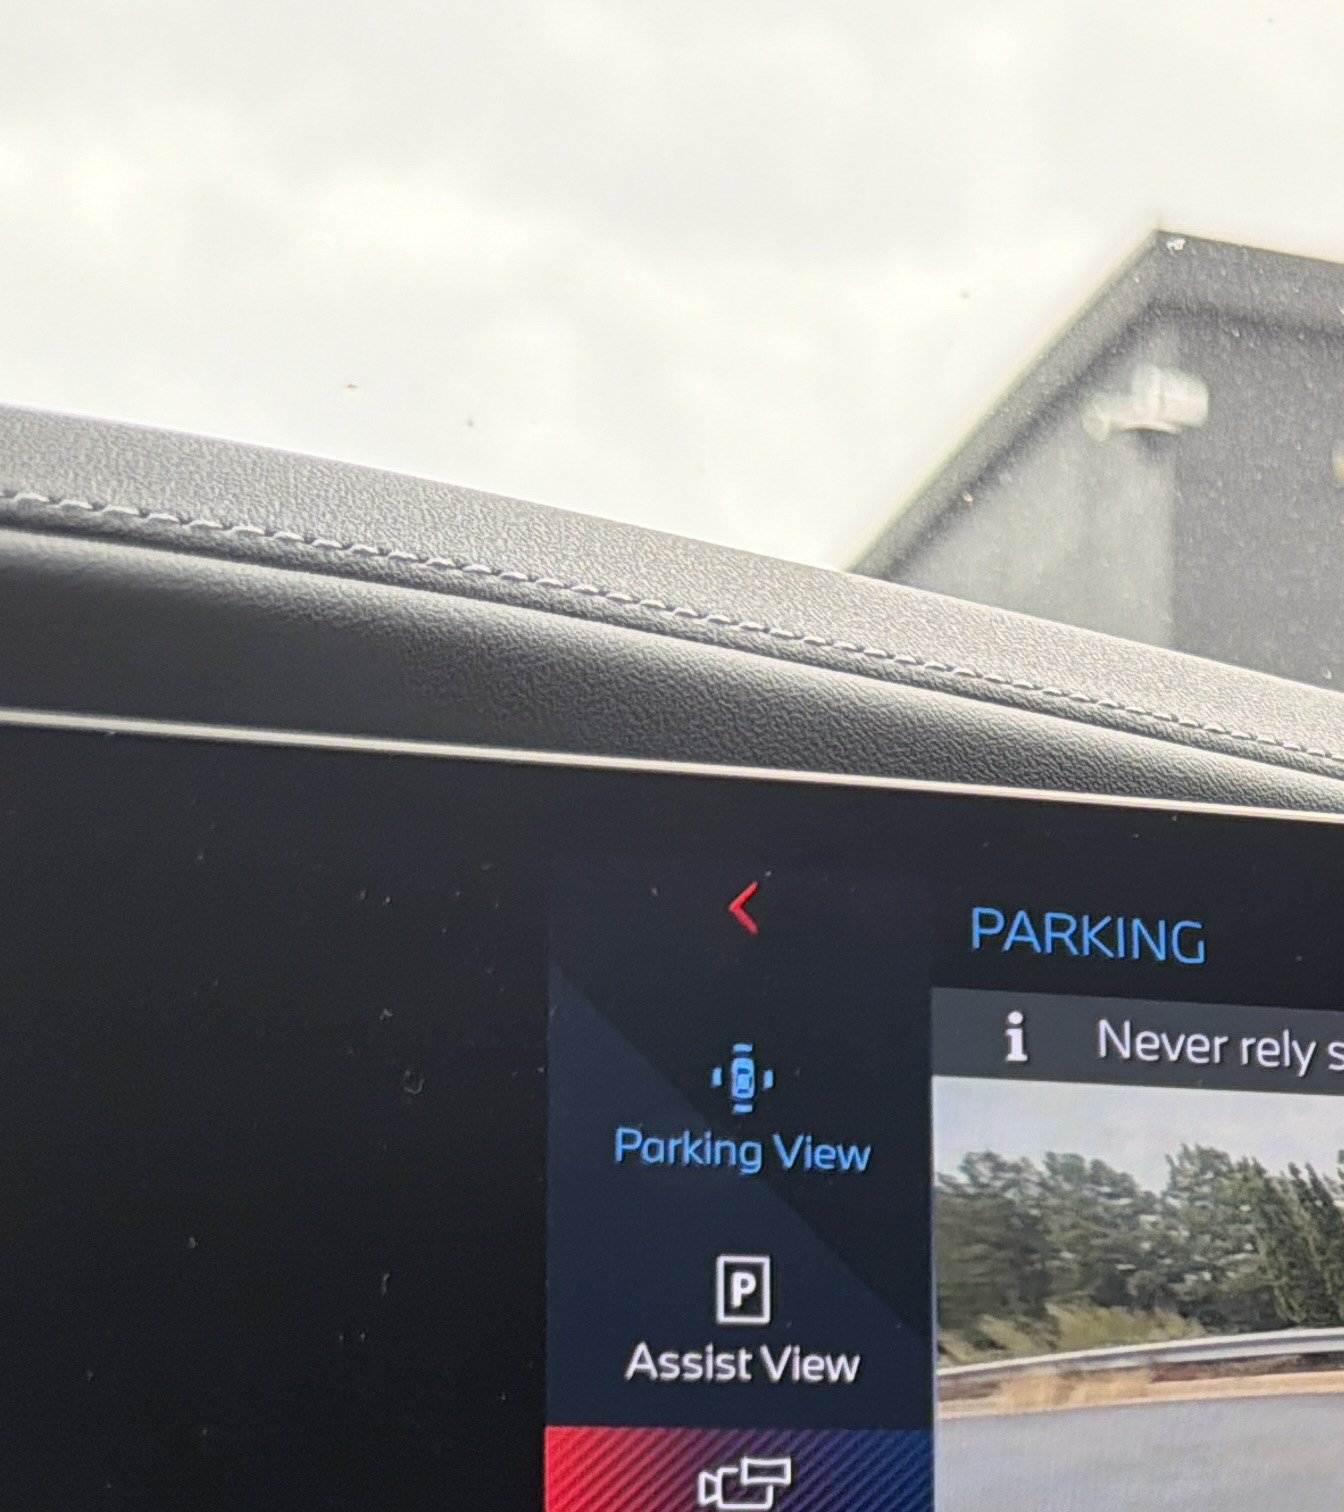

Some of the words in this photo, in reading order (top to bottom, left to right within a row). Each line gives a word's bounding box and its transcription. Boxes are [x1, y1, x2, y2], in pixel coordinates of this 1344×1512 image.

[971, 908, 1206, 964] PARKING
[1098, 1020, 1228, 1064] Never
[1240, 1036, 1317, 1076] rely
[615, 1127, 762, 1174] Parking
[773, 1134, 871, 1172] View
[625, 1342, 752, 1382] Assist
[761, 1347, 860, 1382] View
